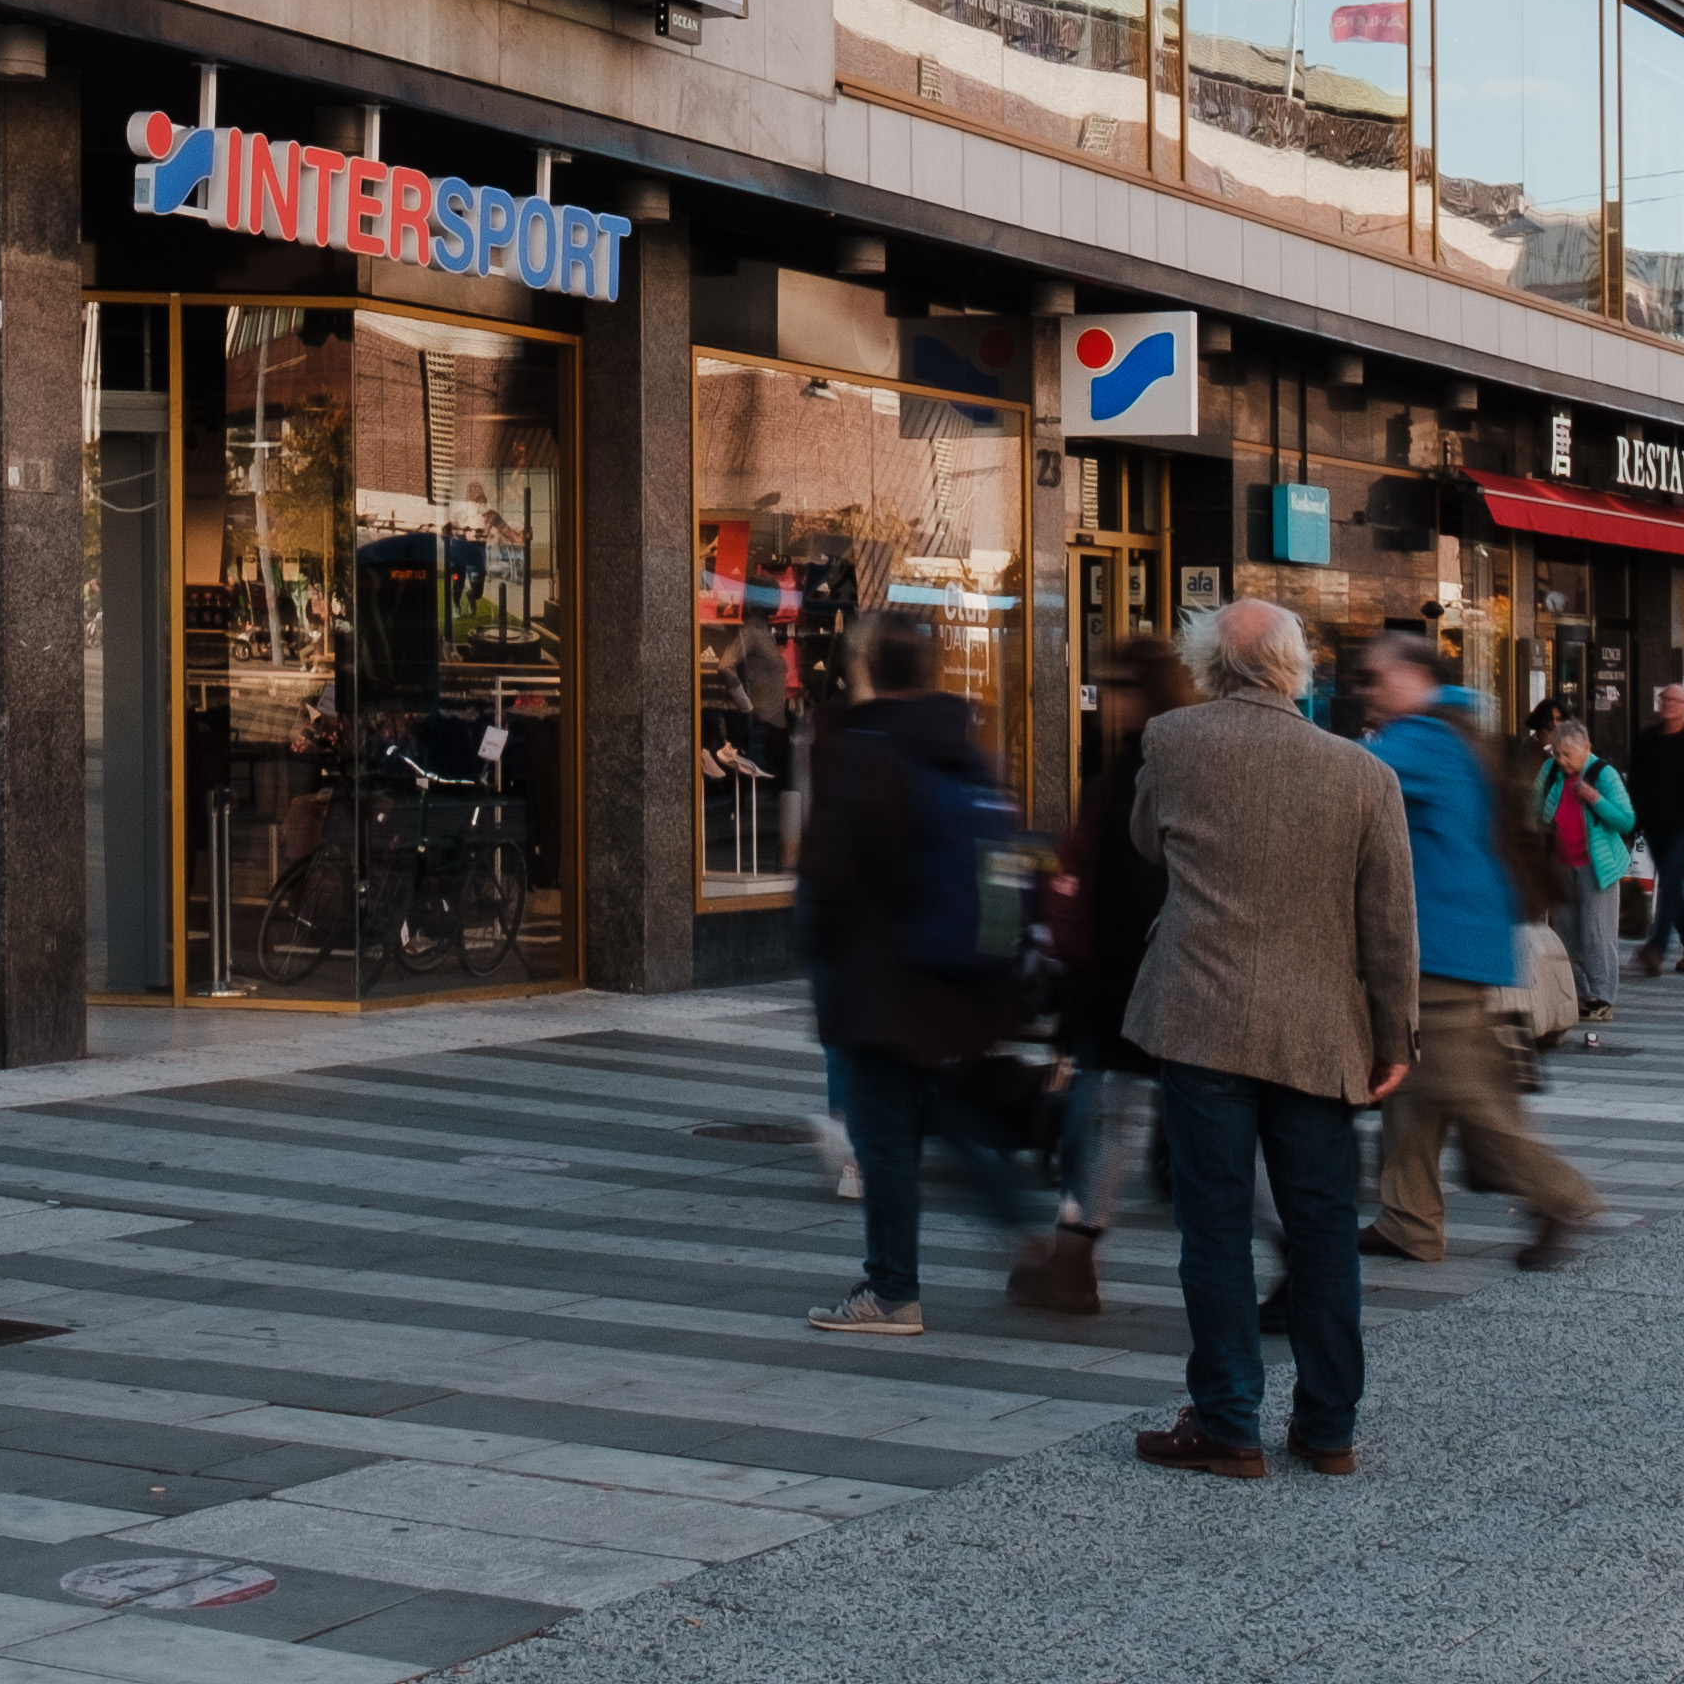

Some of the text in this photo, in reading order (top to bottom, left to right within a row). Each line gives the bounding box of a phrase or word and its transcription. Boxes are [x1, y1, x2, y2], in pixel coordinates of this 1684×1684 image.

[672, 13, 698, 32] OCEAN
[219, 126, 632, 302] INTERSPORT
[1036, 448, 1062, 488] 23
[1186, 570, 1214, 592] afa
[944, 581, 989, 623] Club
